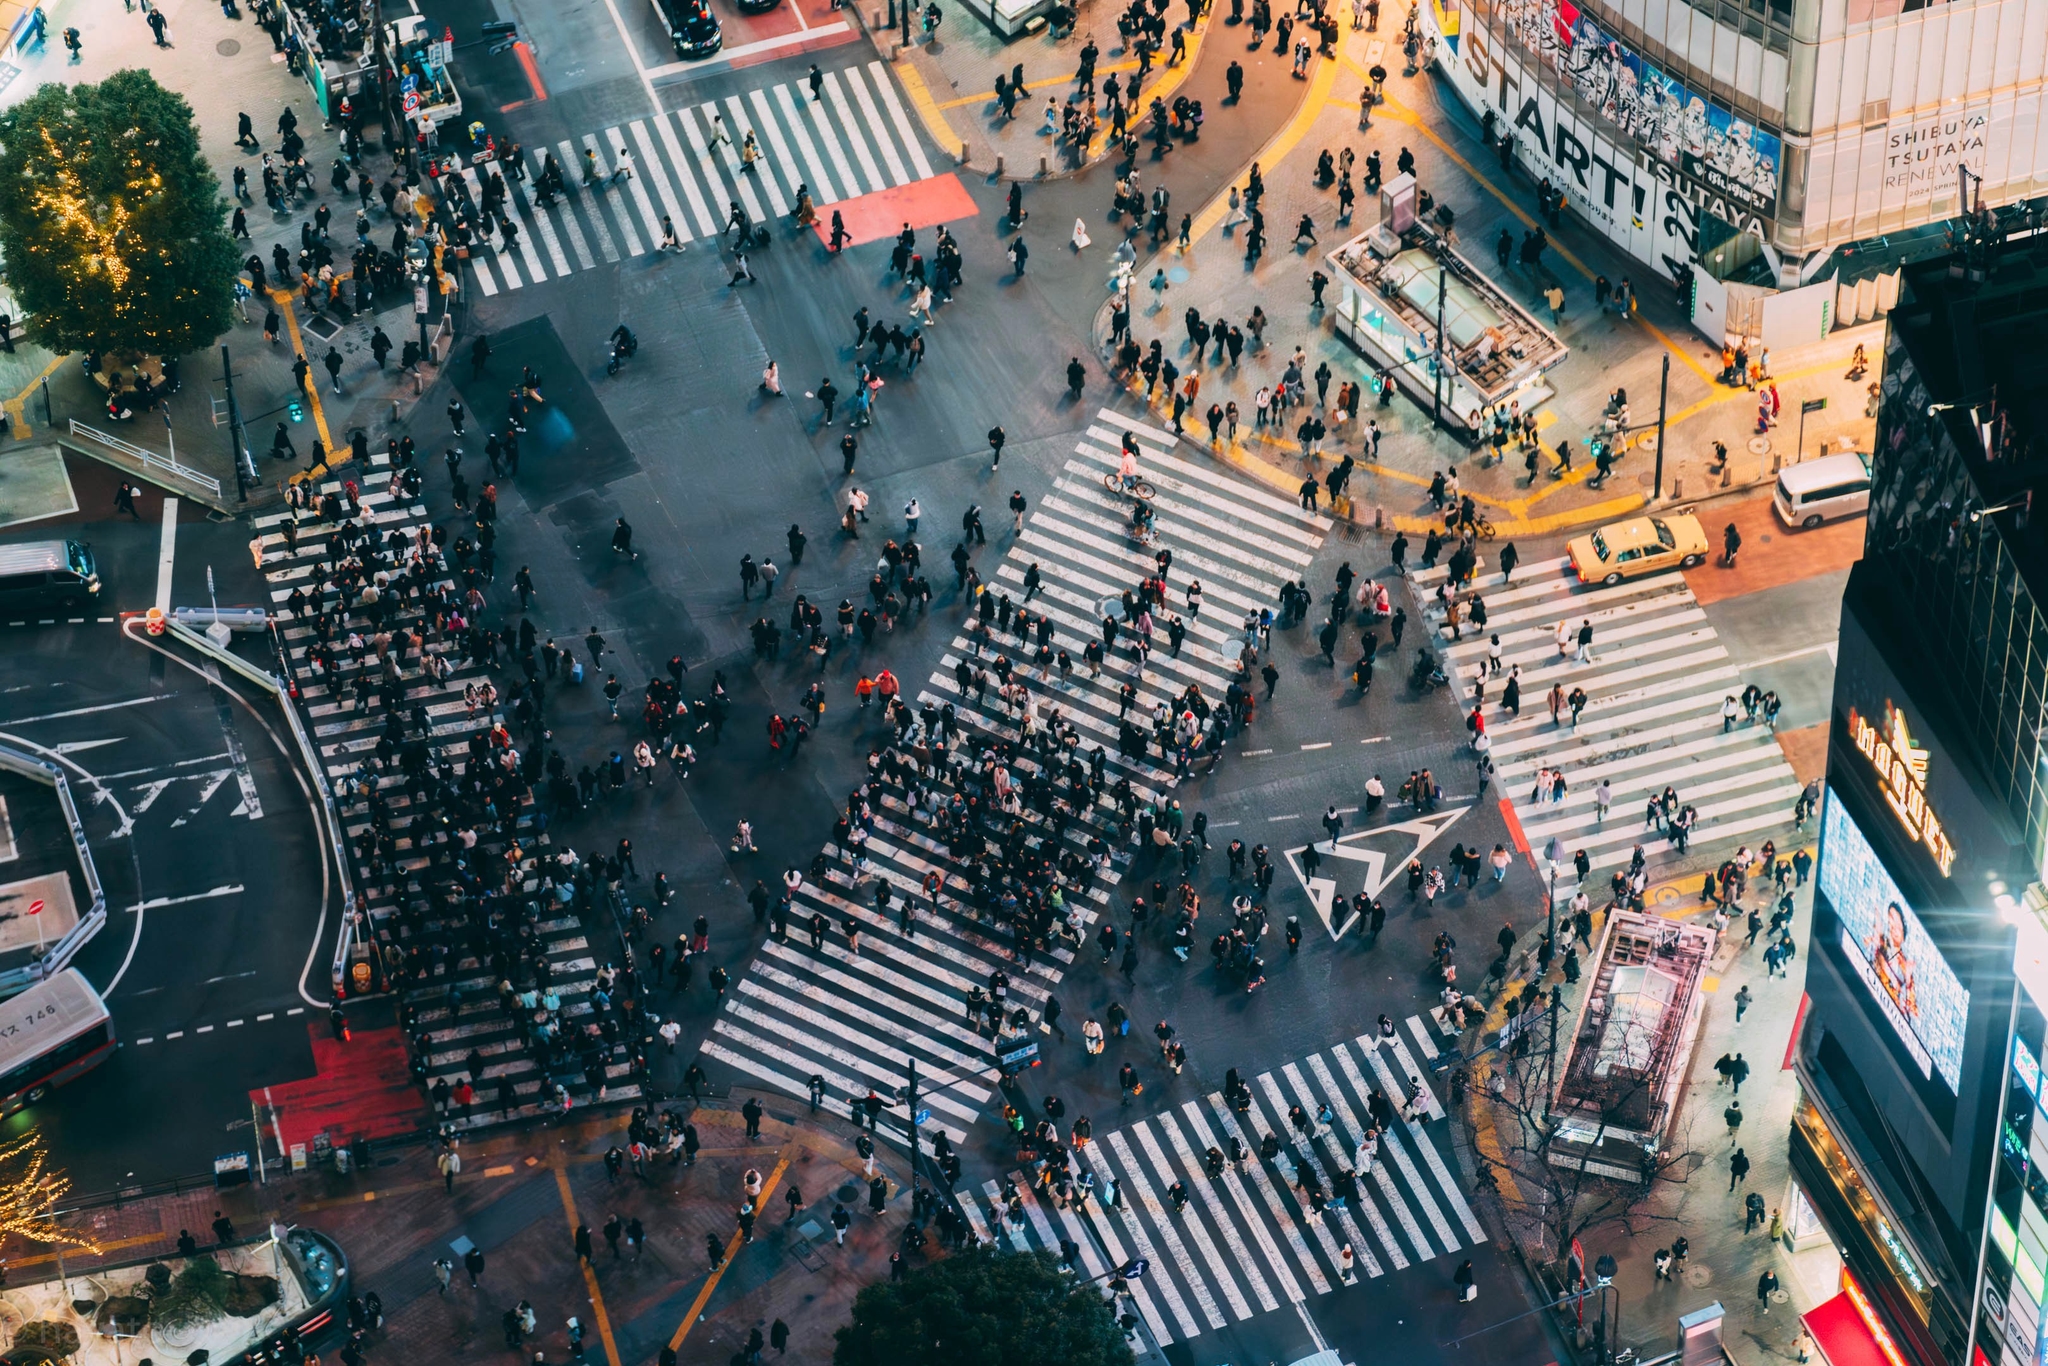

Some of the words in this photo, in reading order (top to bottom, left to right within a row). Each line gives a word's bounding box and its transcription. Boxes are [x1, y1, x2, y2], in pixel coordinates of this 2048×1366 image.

[1890, 116, 1986, 148] SHIBUYA
[1888, 136, 1984, 168] TSUTAYA
[1639, 149, 1766, 242] TSUTAYA
[1933, 181, 1959, 191] SPRIN
